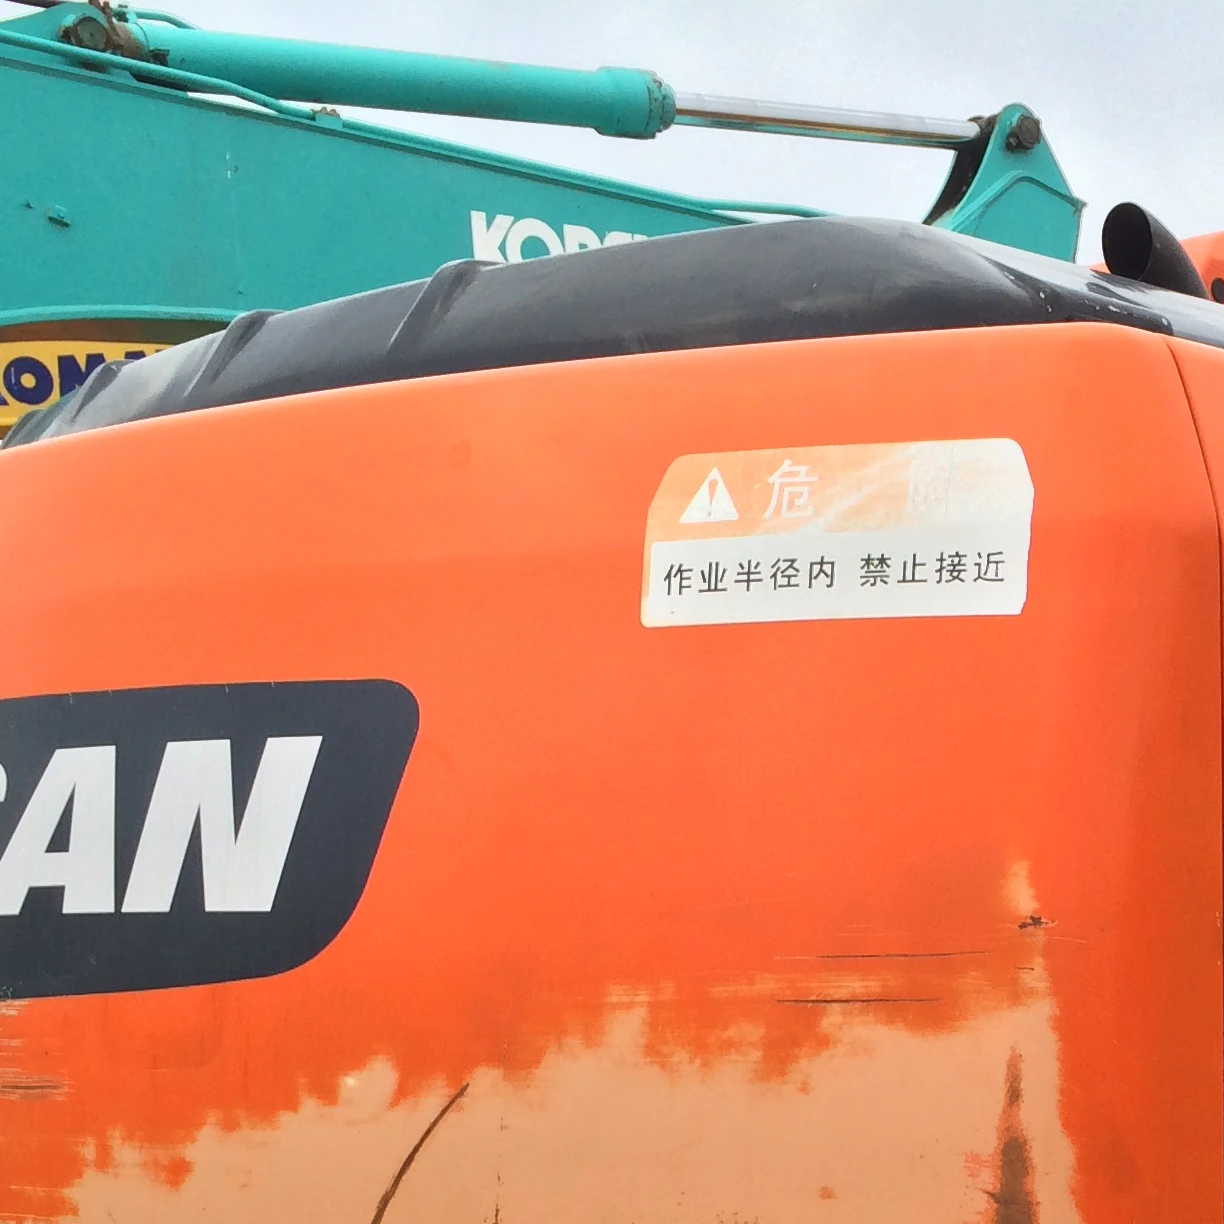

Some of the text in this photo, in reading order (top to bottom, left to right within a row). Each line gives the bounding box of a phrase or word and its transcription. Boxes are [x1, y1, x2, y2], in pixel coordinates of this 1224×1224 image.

[663, 550, 1007, 597] 作业半径内 禁止接近
[0, 735, 323, 916] AN
